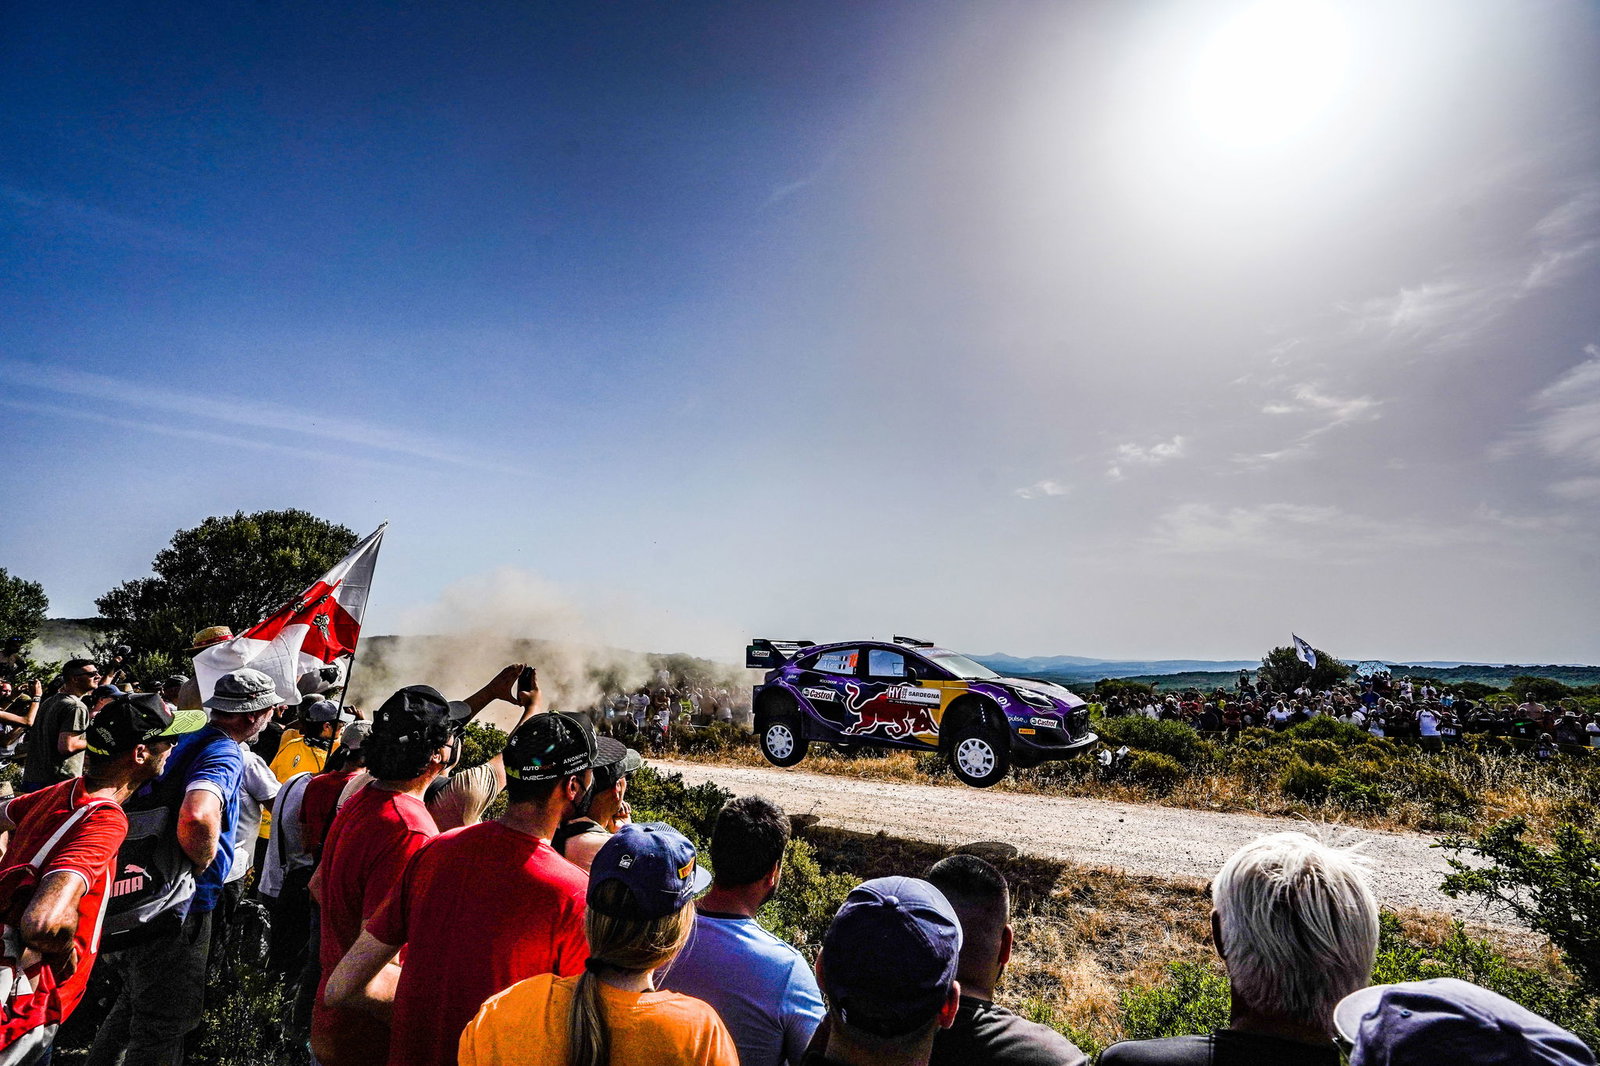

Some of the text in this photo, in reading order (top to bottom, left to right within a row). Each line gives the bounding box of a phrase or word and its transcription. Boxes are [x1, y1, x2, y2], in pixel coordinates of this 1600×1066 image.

[809, 689, 833, 700] Castrol
[908, 691, 940, 699] SARDEGNA
[1037, 718, 1056, 727] Castrol
[563, 752, 588, 765] ANONIMO
